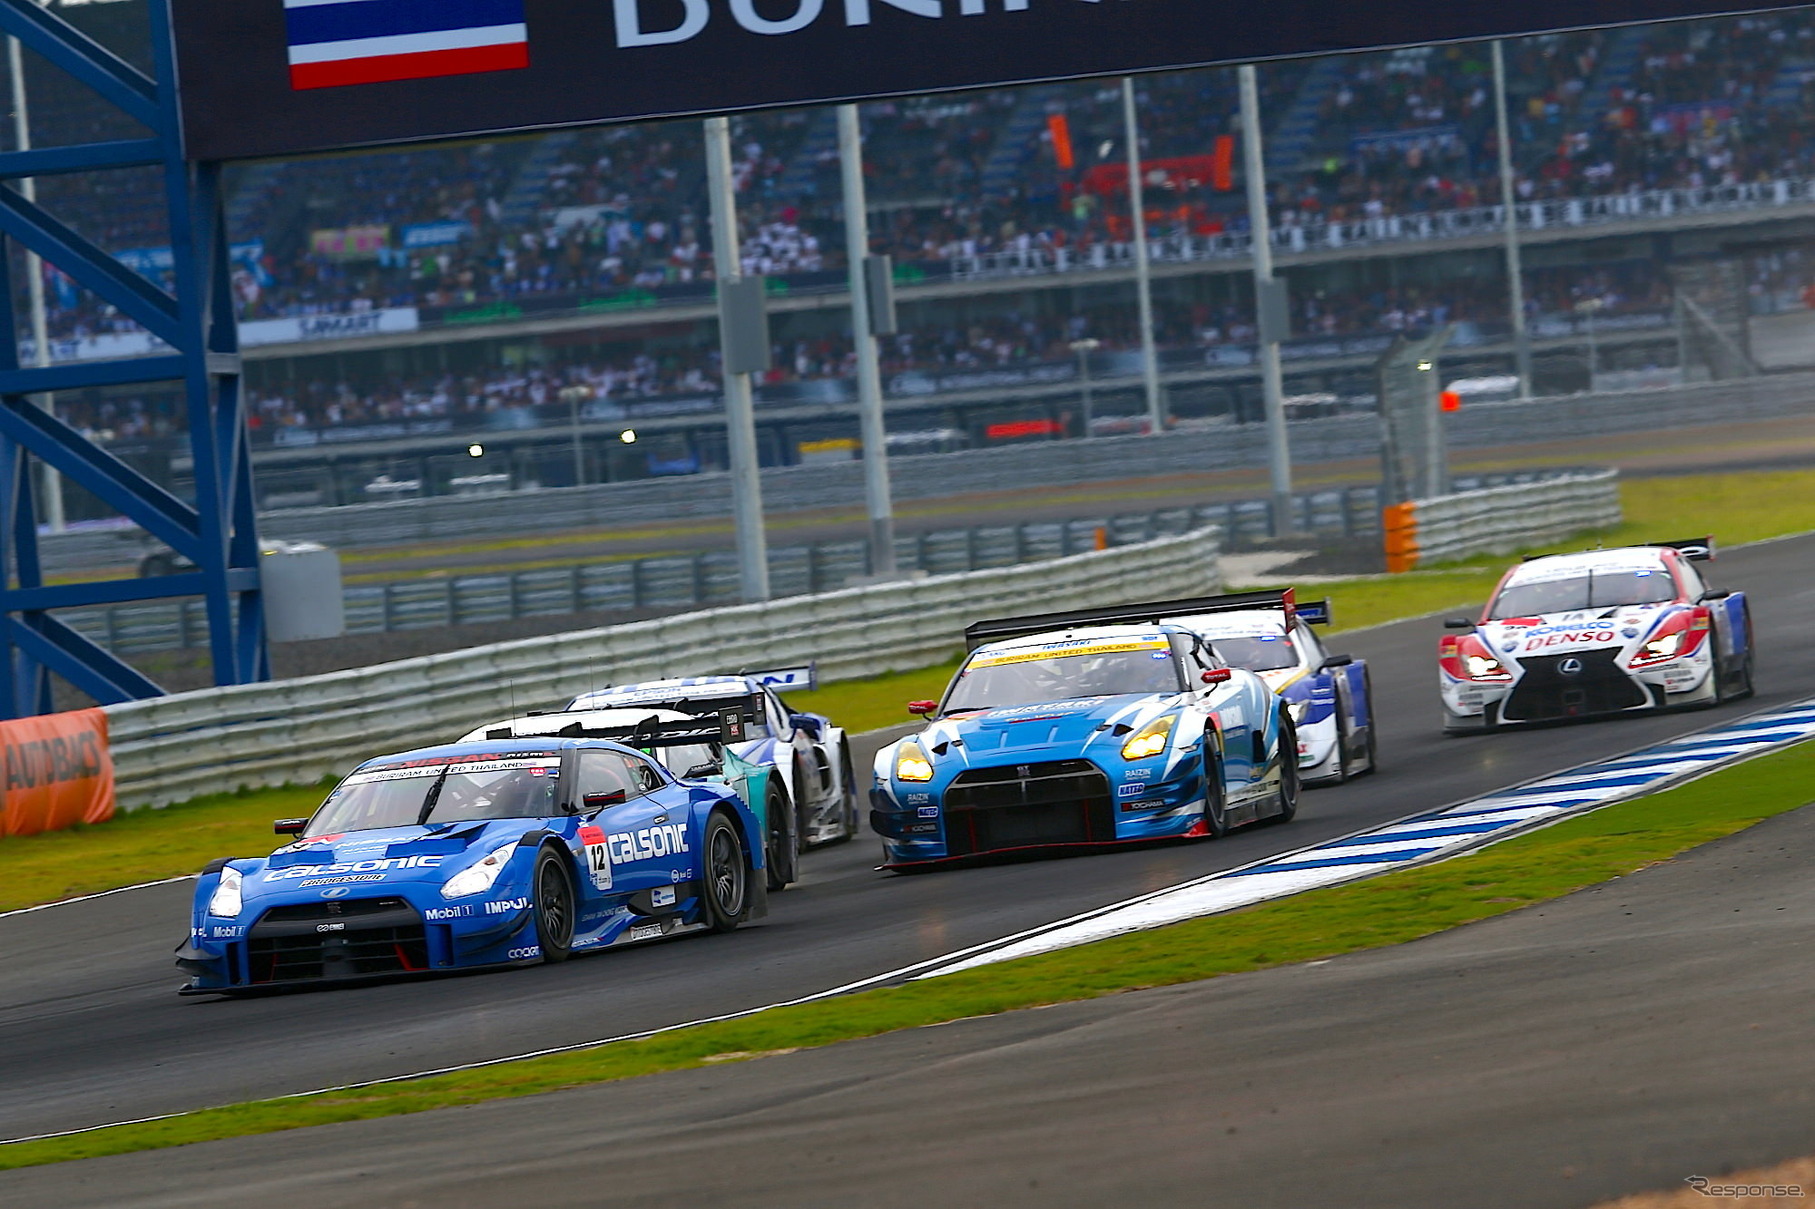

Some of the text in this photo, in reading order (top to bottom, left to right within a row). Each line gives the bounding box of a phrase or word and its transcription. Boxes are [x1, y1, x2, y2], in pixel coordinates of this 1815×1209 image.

[1526, 631, 1614, 651] DENSO
[470, 762, 523, 771] THAILAND
[591, 845, 605, 871] 12
[425, 906, 461, 920] Mobil
[213, 926, 236, 937] Mobil
